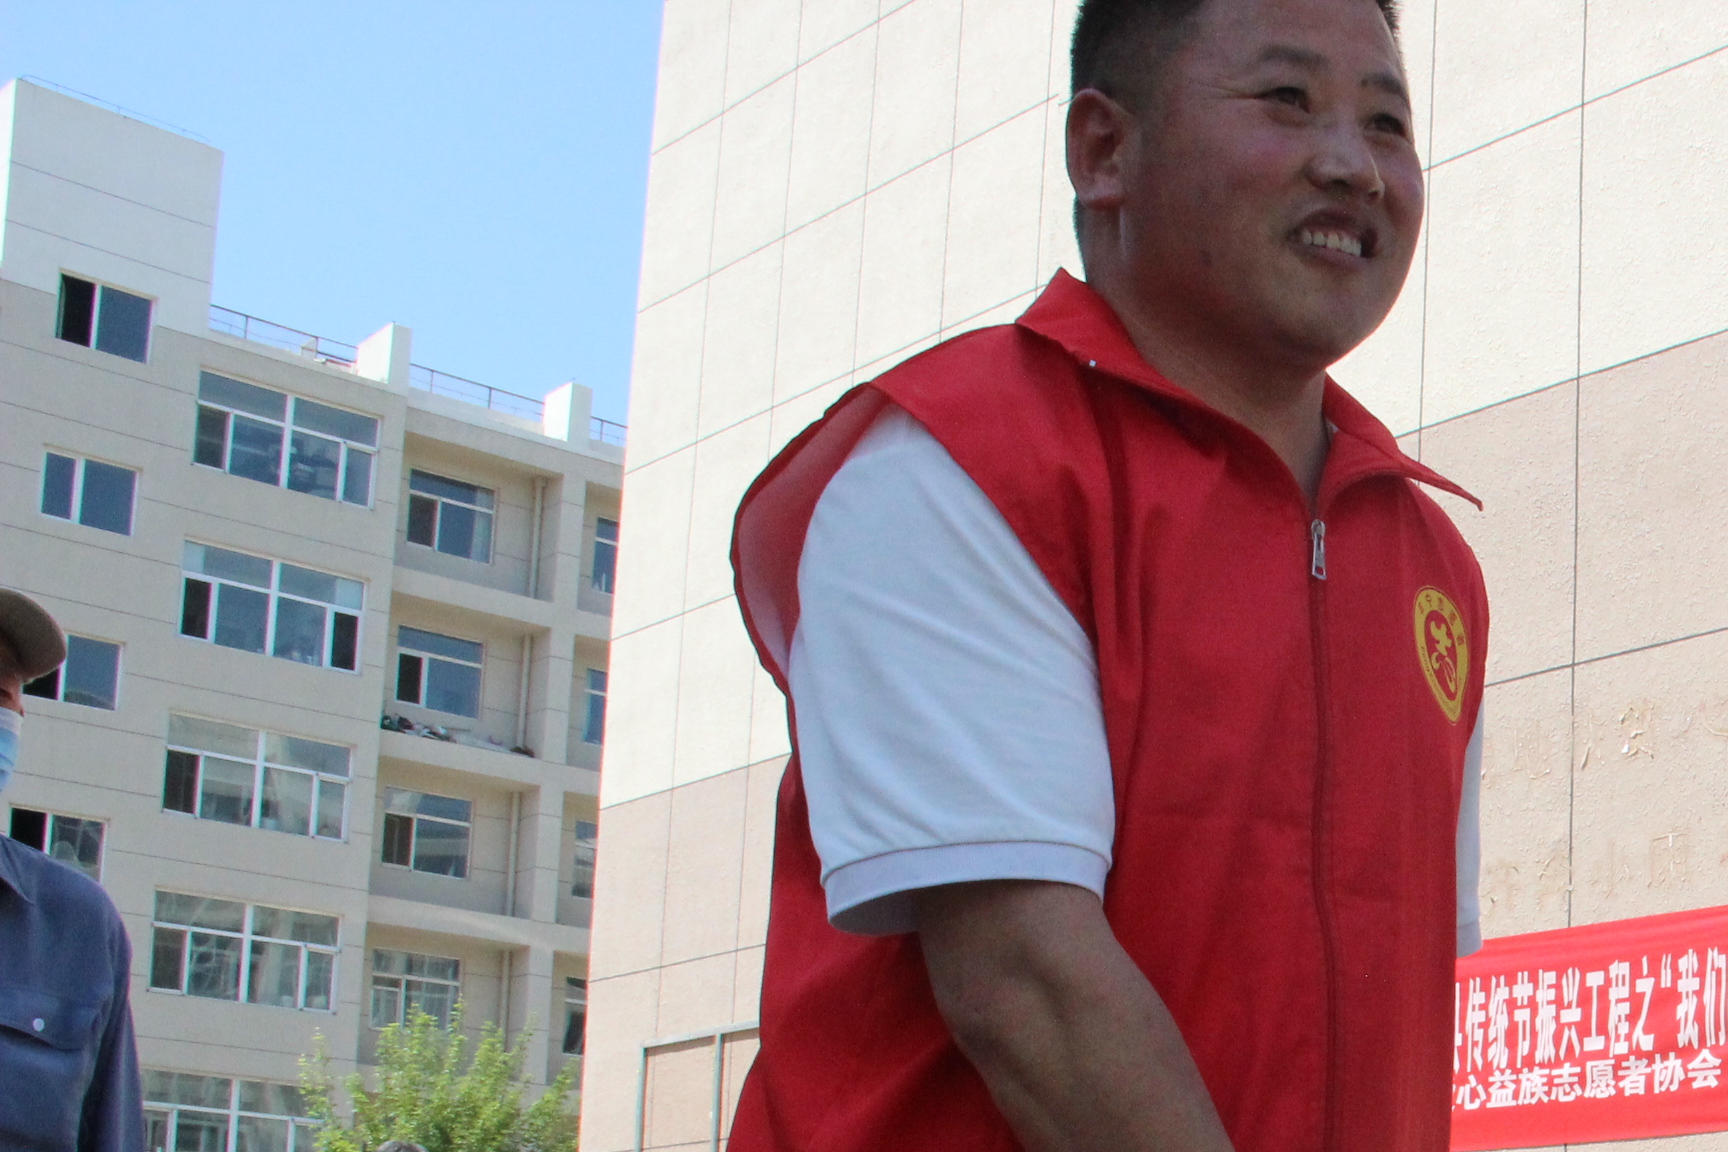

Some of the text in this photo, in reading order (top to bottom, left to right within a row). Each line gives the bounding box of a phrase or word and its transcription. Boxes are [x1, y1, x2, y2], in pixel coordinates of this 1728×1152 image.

[1452, 1048, 1722, 1111] 心益族志愿者协会
